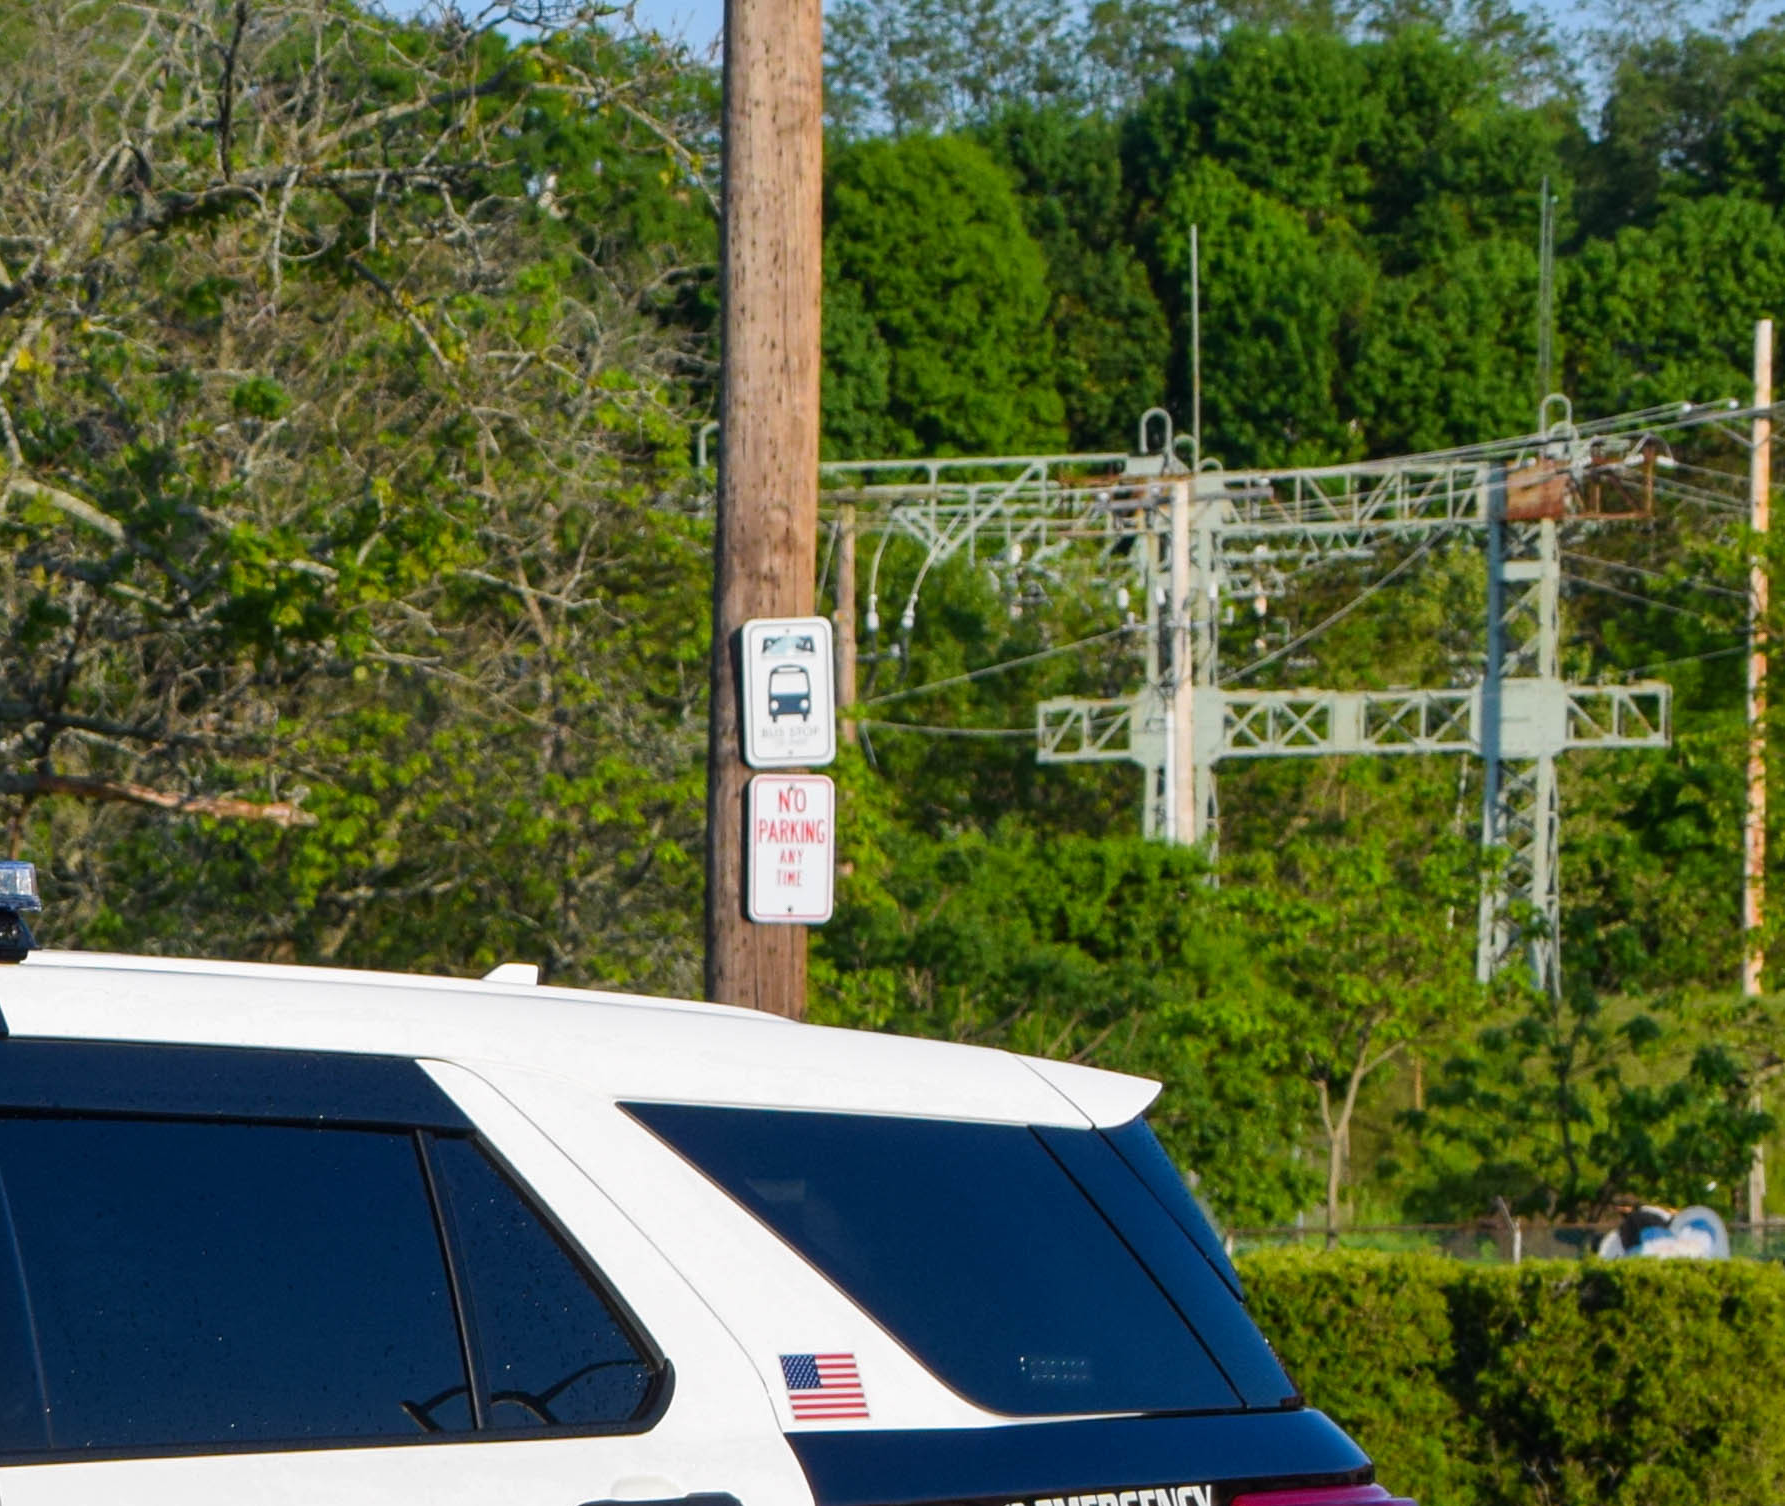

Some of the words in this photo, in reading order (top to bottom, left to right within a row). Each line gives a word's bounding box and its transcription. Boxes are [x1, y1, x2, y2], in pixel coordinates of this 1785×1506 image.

[778, 788, 807, 813] NO
[758, 819, 826, 844] PARKING
[780, 848, 804, 864] ANY
[776, 869, 802, 887] TIME
